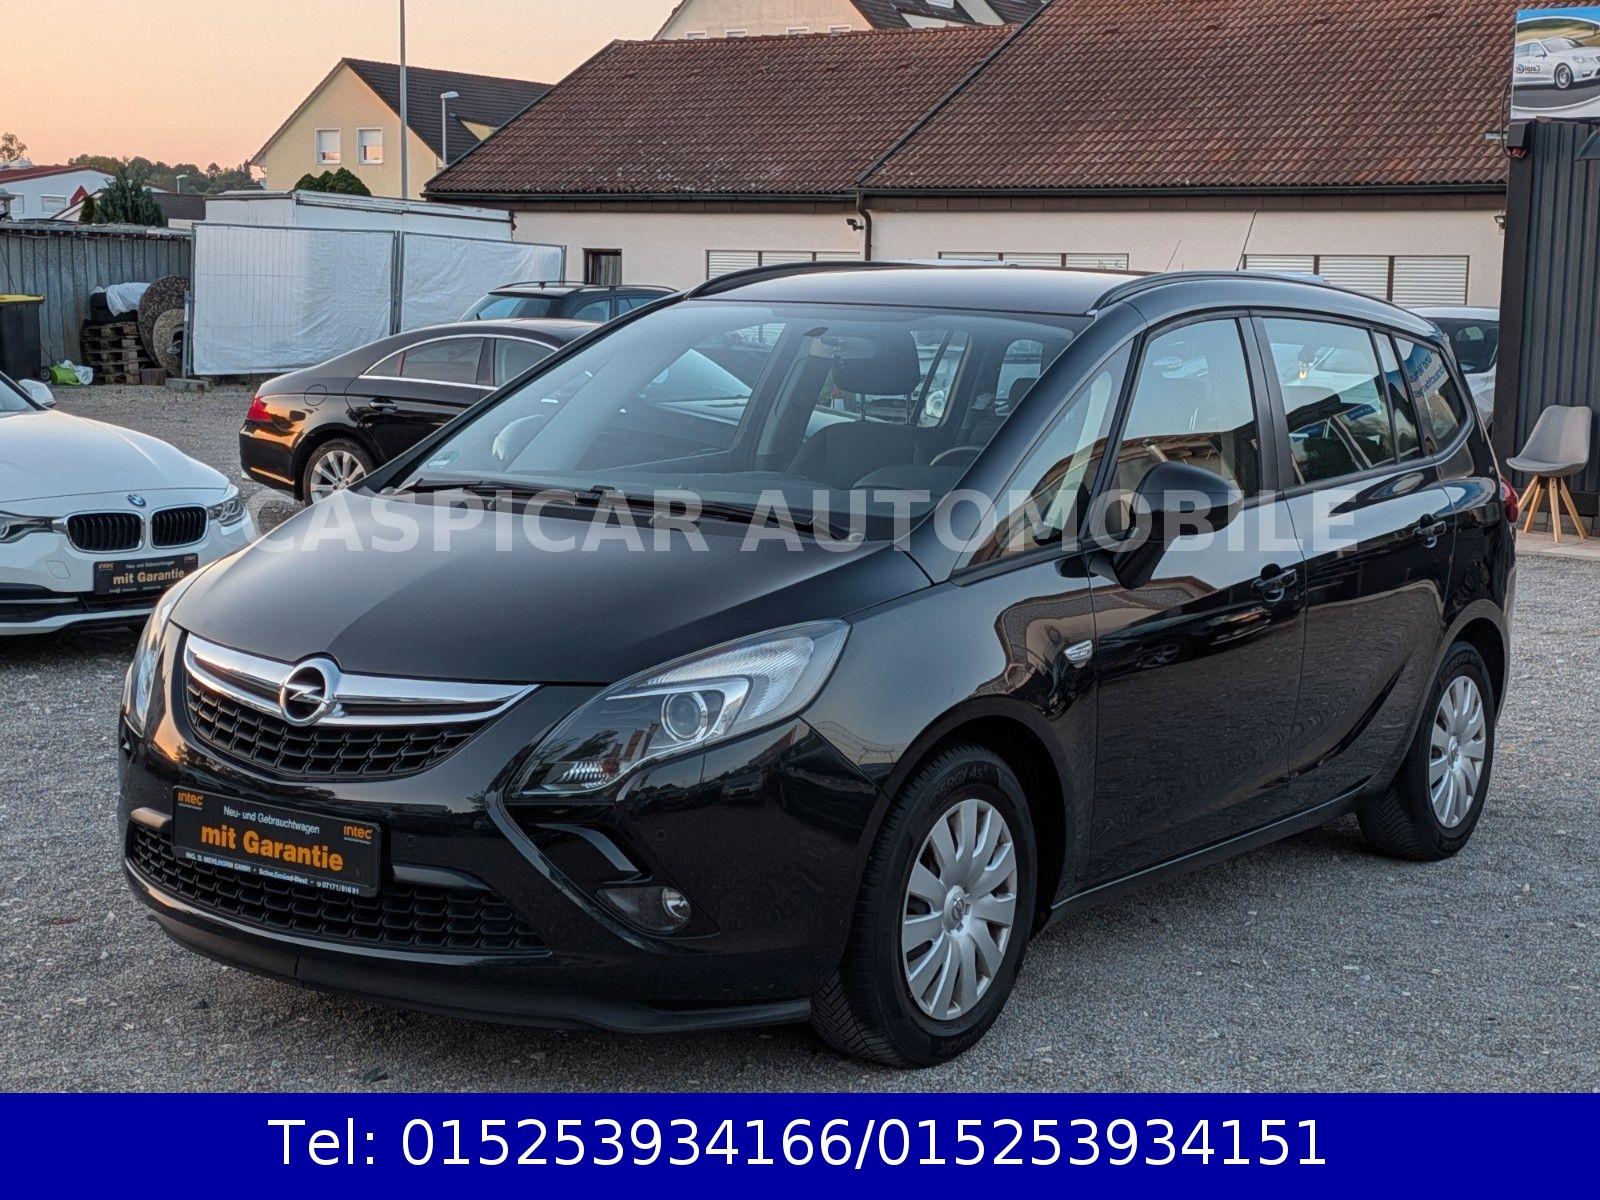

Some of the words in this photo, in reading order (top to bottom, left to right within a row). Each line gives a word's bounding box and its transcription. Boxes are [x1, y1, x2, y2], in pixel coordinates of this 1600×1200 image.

[113, 573, 134, 585] mit
[137, 568, 185, 583] Garantie
[223, 805, 241, 818] Neu-
[242, 811, 257, 822] und
[257, 812, 320, 835] Gebrauchtwagen
[201, 824, 236, 850] mit
[243, 830, 344, 872] Garantie
